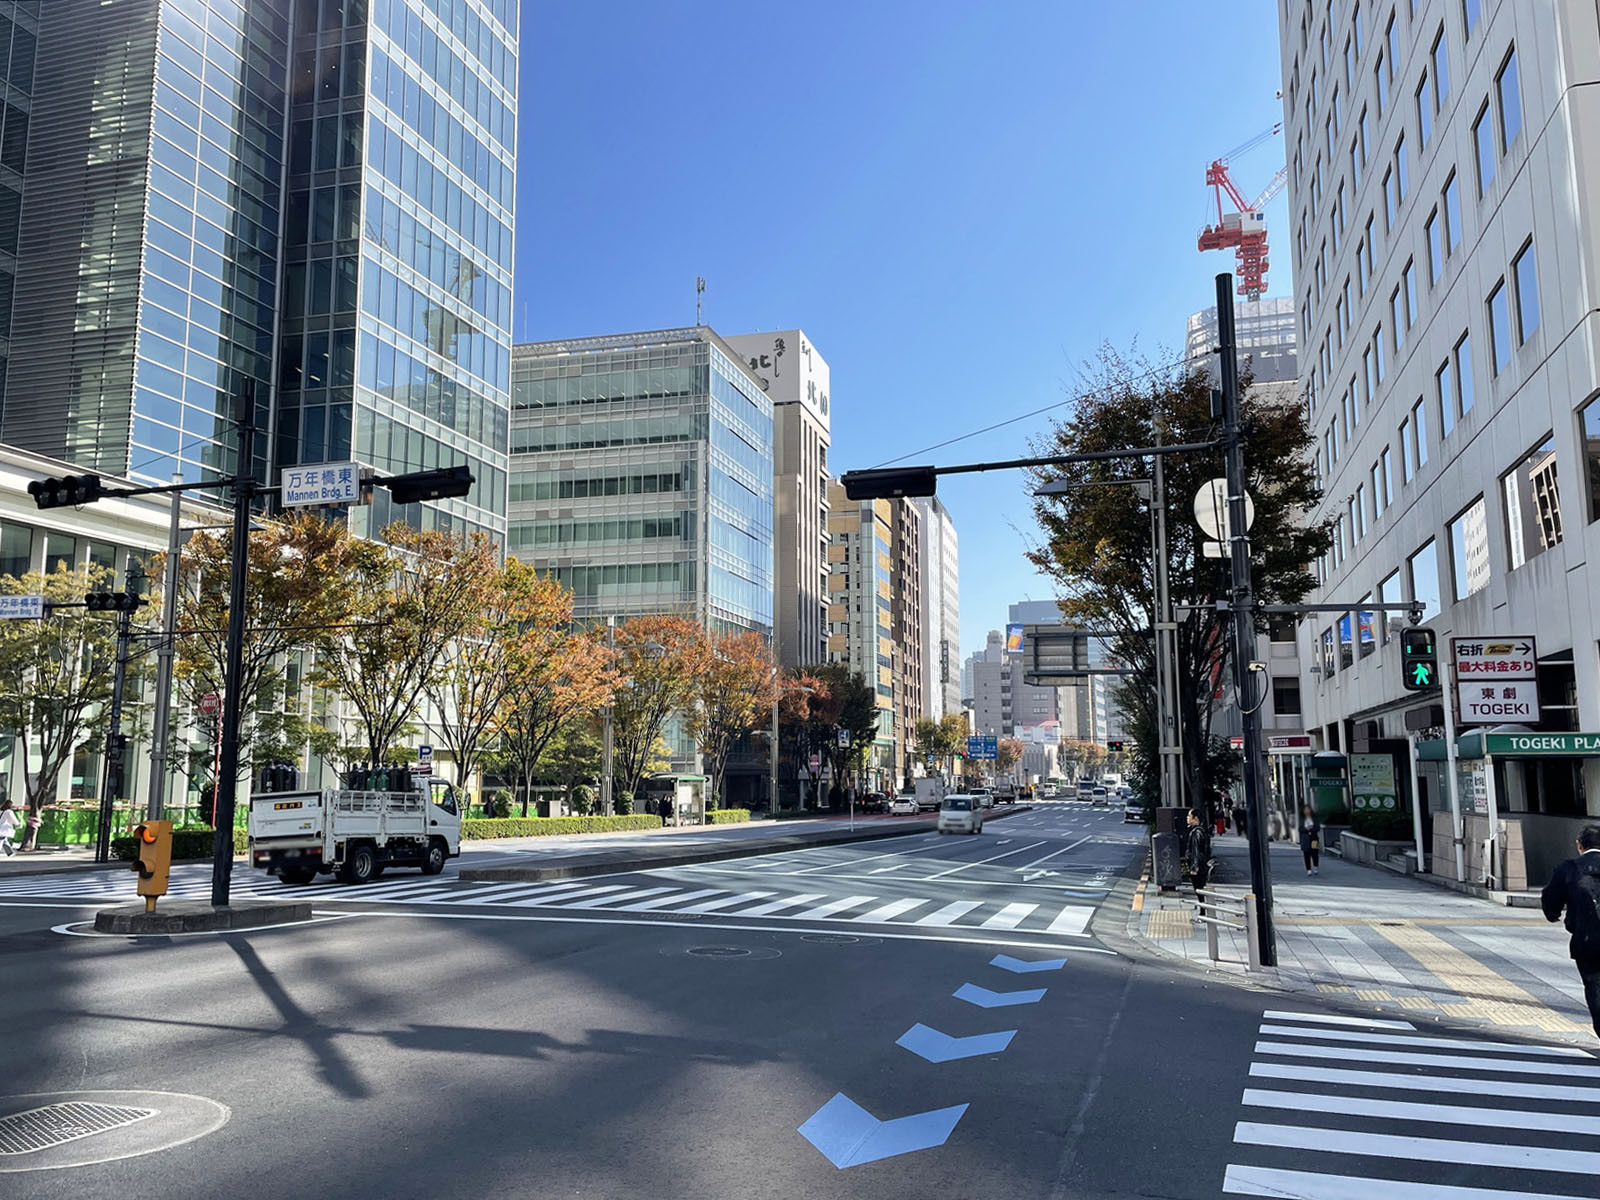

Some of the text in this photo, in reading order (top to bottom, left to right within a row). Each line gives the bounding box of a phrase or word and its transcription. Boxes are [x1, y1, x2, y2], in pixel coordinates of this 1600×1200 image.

[288, 468, 352, 488] 万年橋東
[287, 485, 354, 501] Mannen Brdg. E.
[1457, 643, 1483, 656] 右折
[1458, 660, 1534, 673] 最大料金あり
[1481, 687, 1517, 700] 東劇
[1469, 703, 1530, 715] TOGEKI
[1510, 737, 1566, 750] TOGEKI
[419, 745, 433, 760] P
